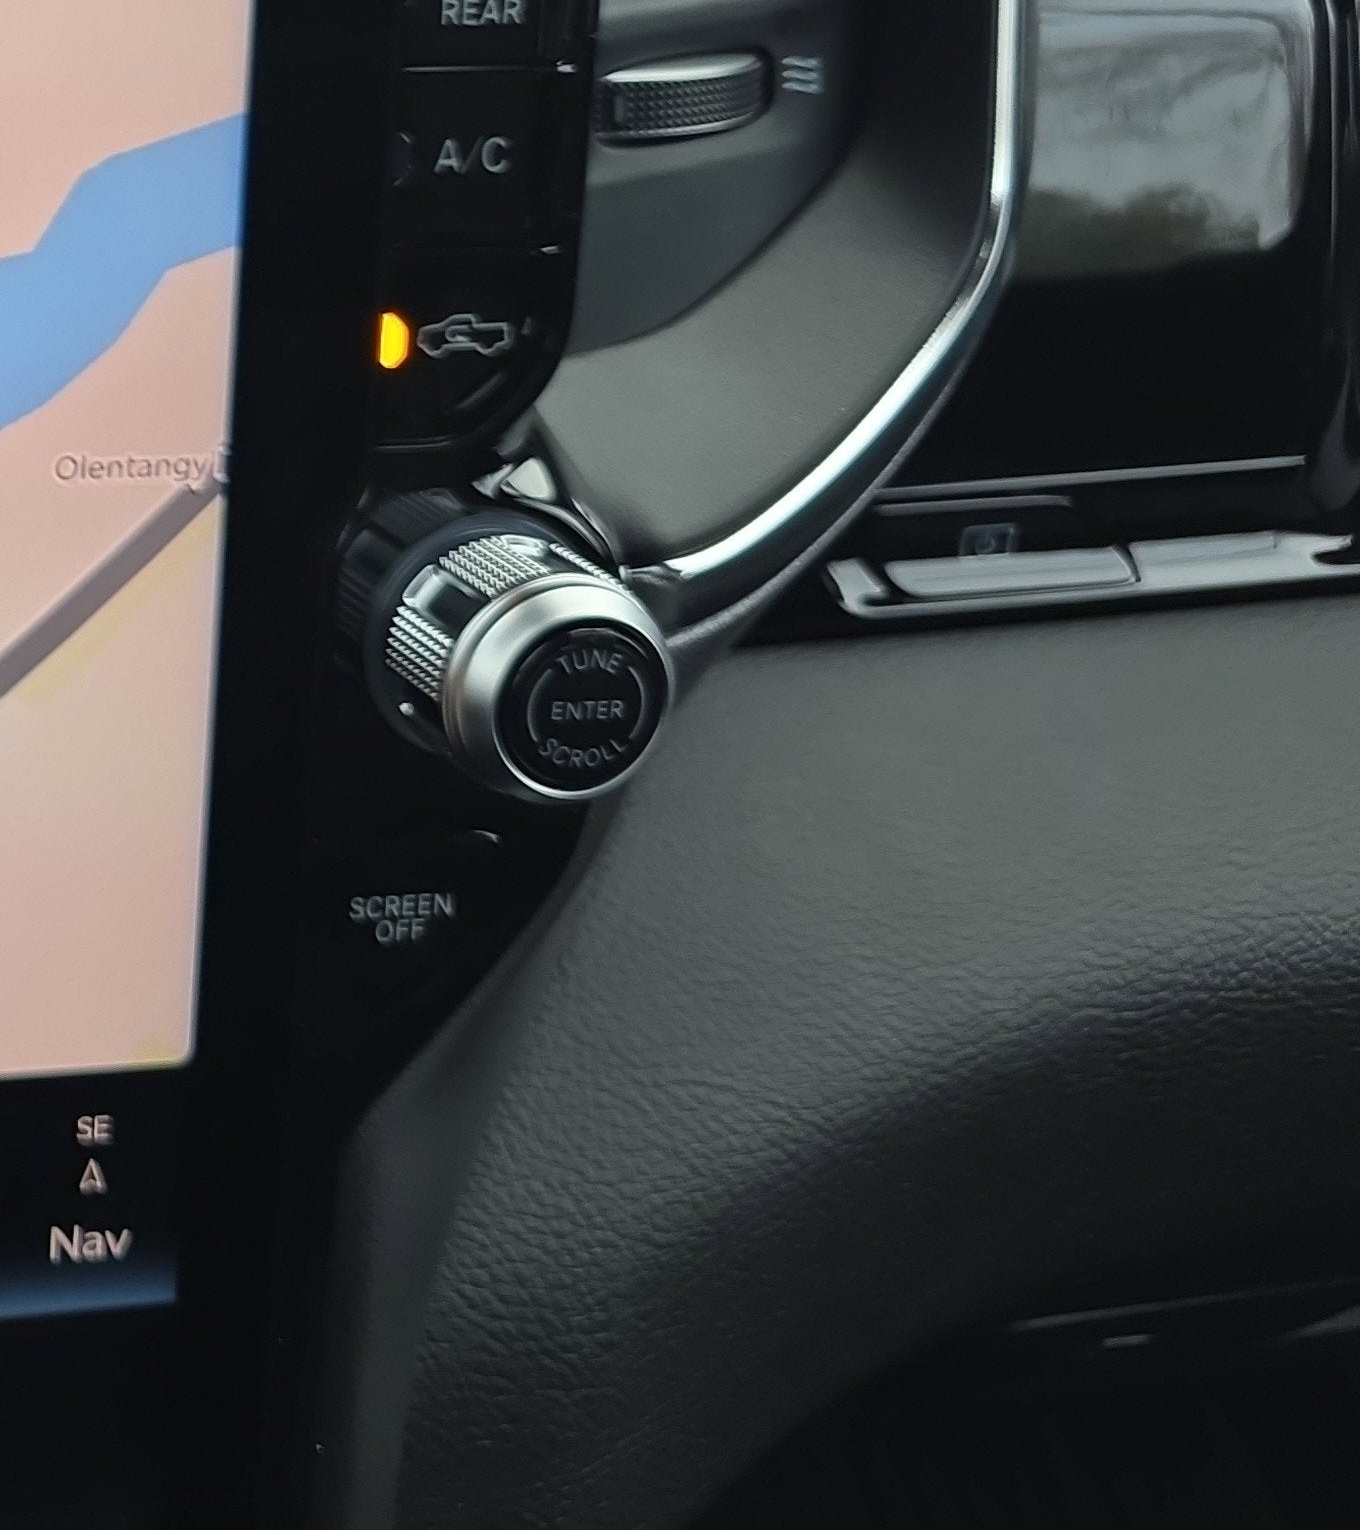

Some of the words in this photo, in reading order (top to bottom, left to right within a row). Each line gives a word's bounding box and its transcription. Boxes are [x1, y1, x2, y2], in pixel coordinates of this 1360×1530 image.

[434, 137, 511, 173] A/C
[55, 455, 207, 481] Olentangy
[558, 650, 625, 675] TUNE
[551, 700, 623, 720] ENTER
[540, 737, 630, 767] SCROLL
[349, 892, 453, 920] SCREEN
[375, 919, 426, 945] OFF
[75, 1115, 114, 1146] SE
[49, 1224, 132, 1265] Nav
